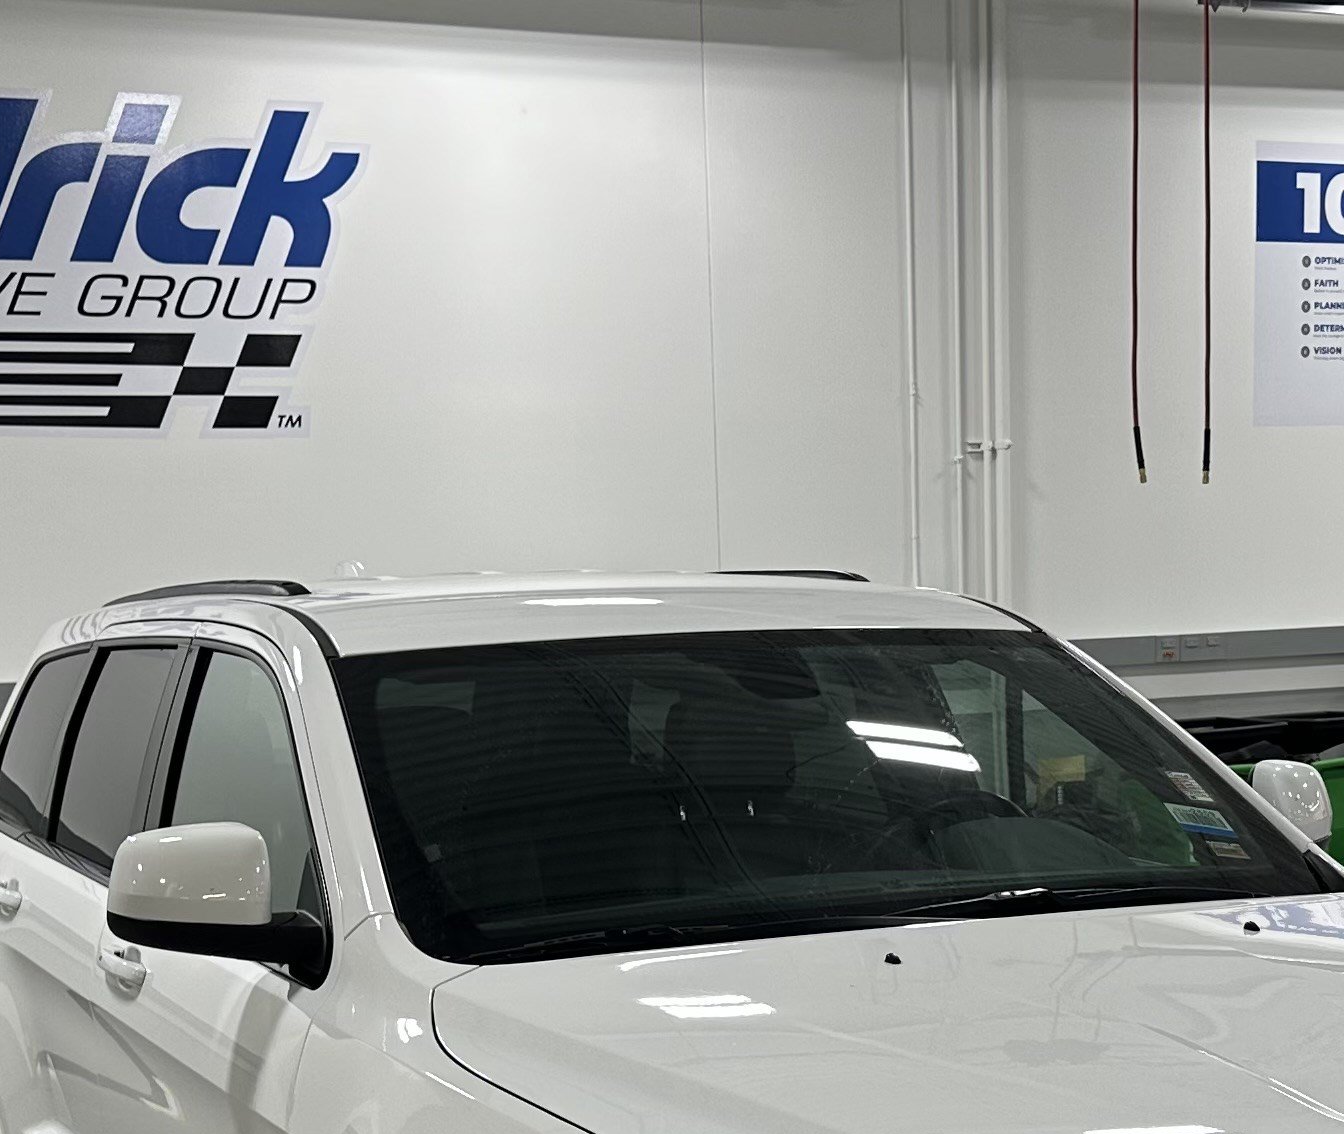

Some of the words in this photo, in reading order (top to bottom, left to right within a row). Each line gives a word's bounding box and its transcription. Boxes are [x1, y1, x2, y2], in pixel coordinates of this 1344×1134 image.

[1314, 279, 1339, 287] FAITH
[76, 275, 317, 320] GROUP
[1313, 346, 1342, 355] VISION
[276, 415, 303, 428] TM
